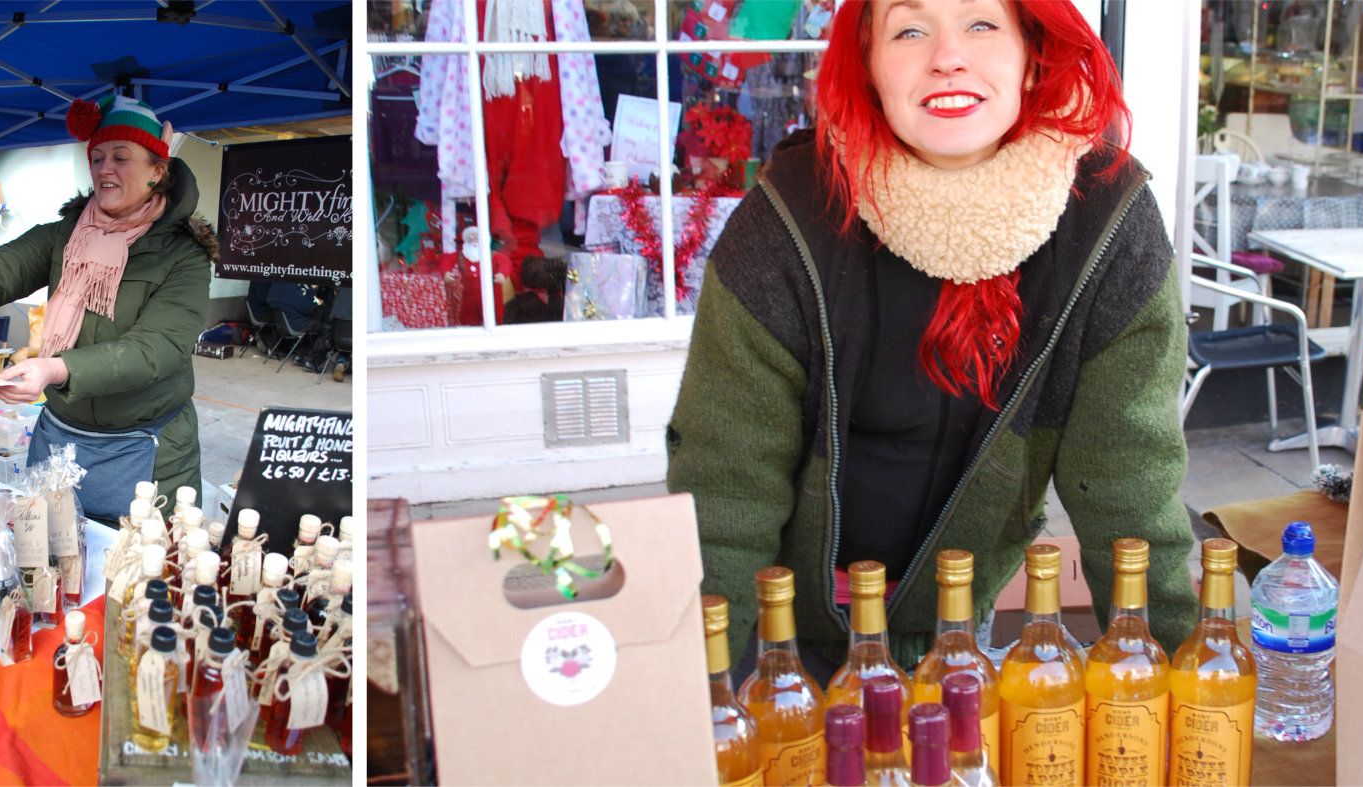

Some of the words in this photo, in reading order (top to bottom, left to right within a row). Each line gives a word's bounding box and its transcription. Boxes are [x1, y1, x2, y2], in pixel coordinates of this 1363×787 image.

[253, 211, 286, 222] And
[291, 208, 323, 222] Well
[263, 434, 302, 449] FRUIT
[301, 435, 315, 450] &
[548, 624, 587, 641] CIDER
[1035, 721, 1070, 734] CIDER
[1105, 713, 1140, 728] CIDER
[1185, 716, 1219, 733] CIDER
[1026, 759, 1076, 773] TOFFEE
[1097, 752, 1148, 766] TOFFEE
[1177, 753, 1226, 769] TOFFEE
